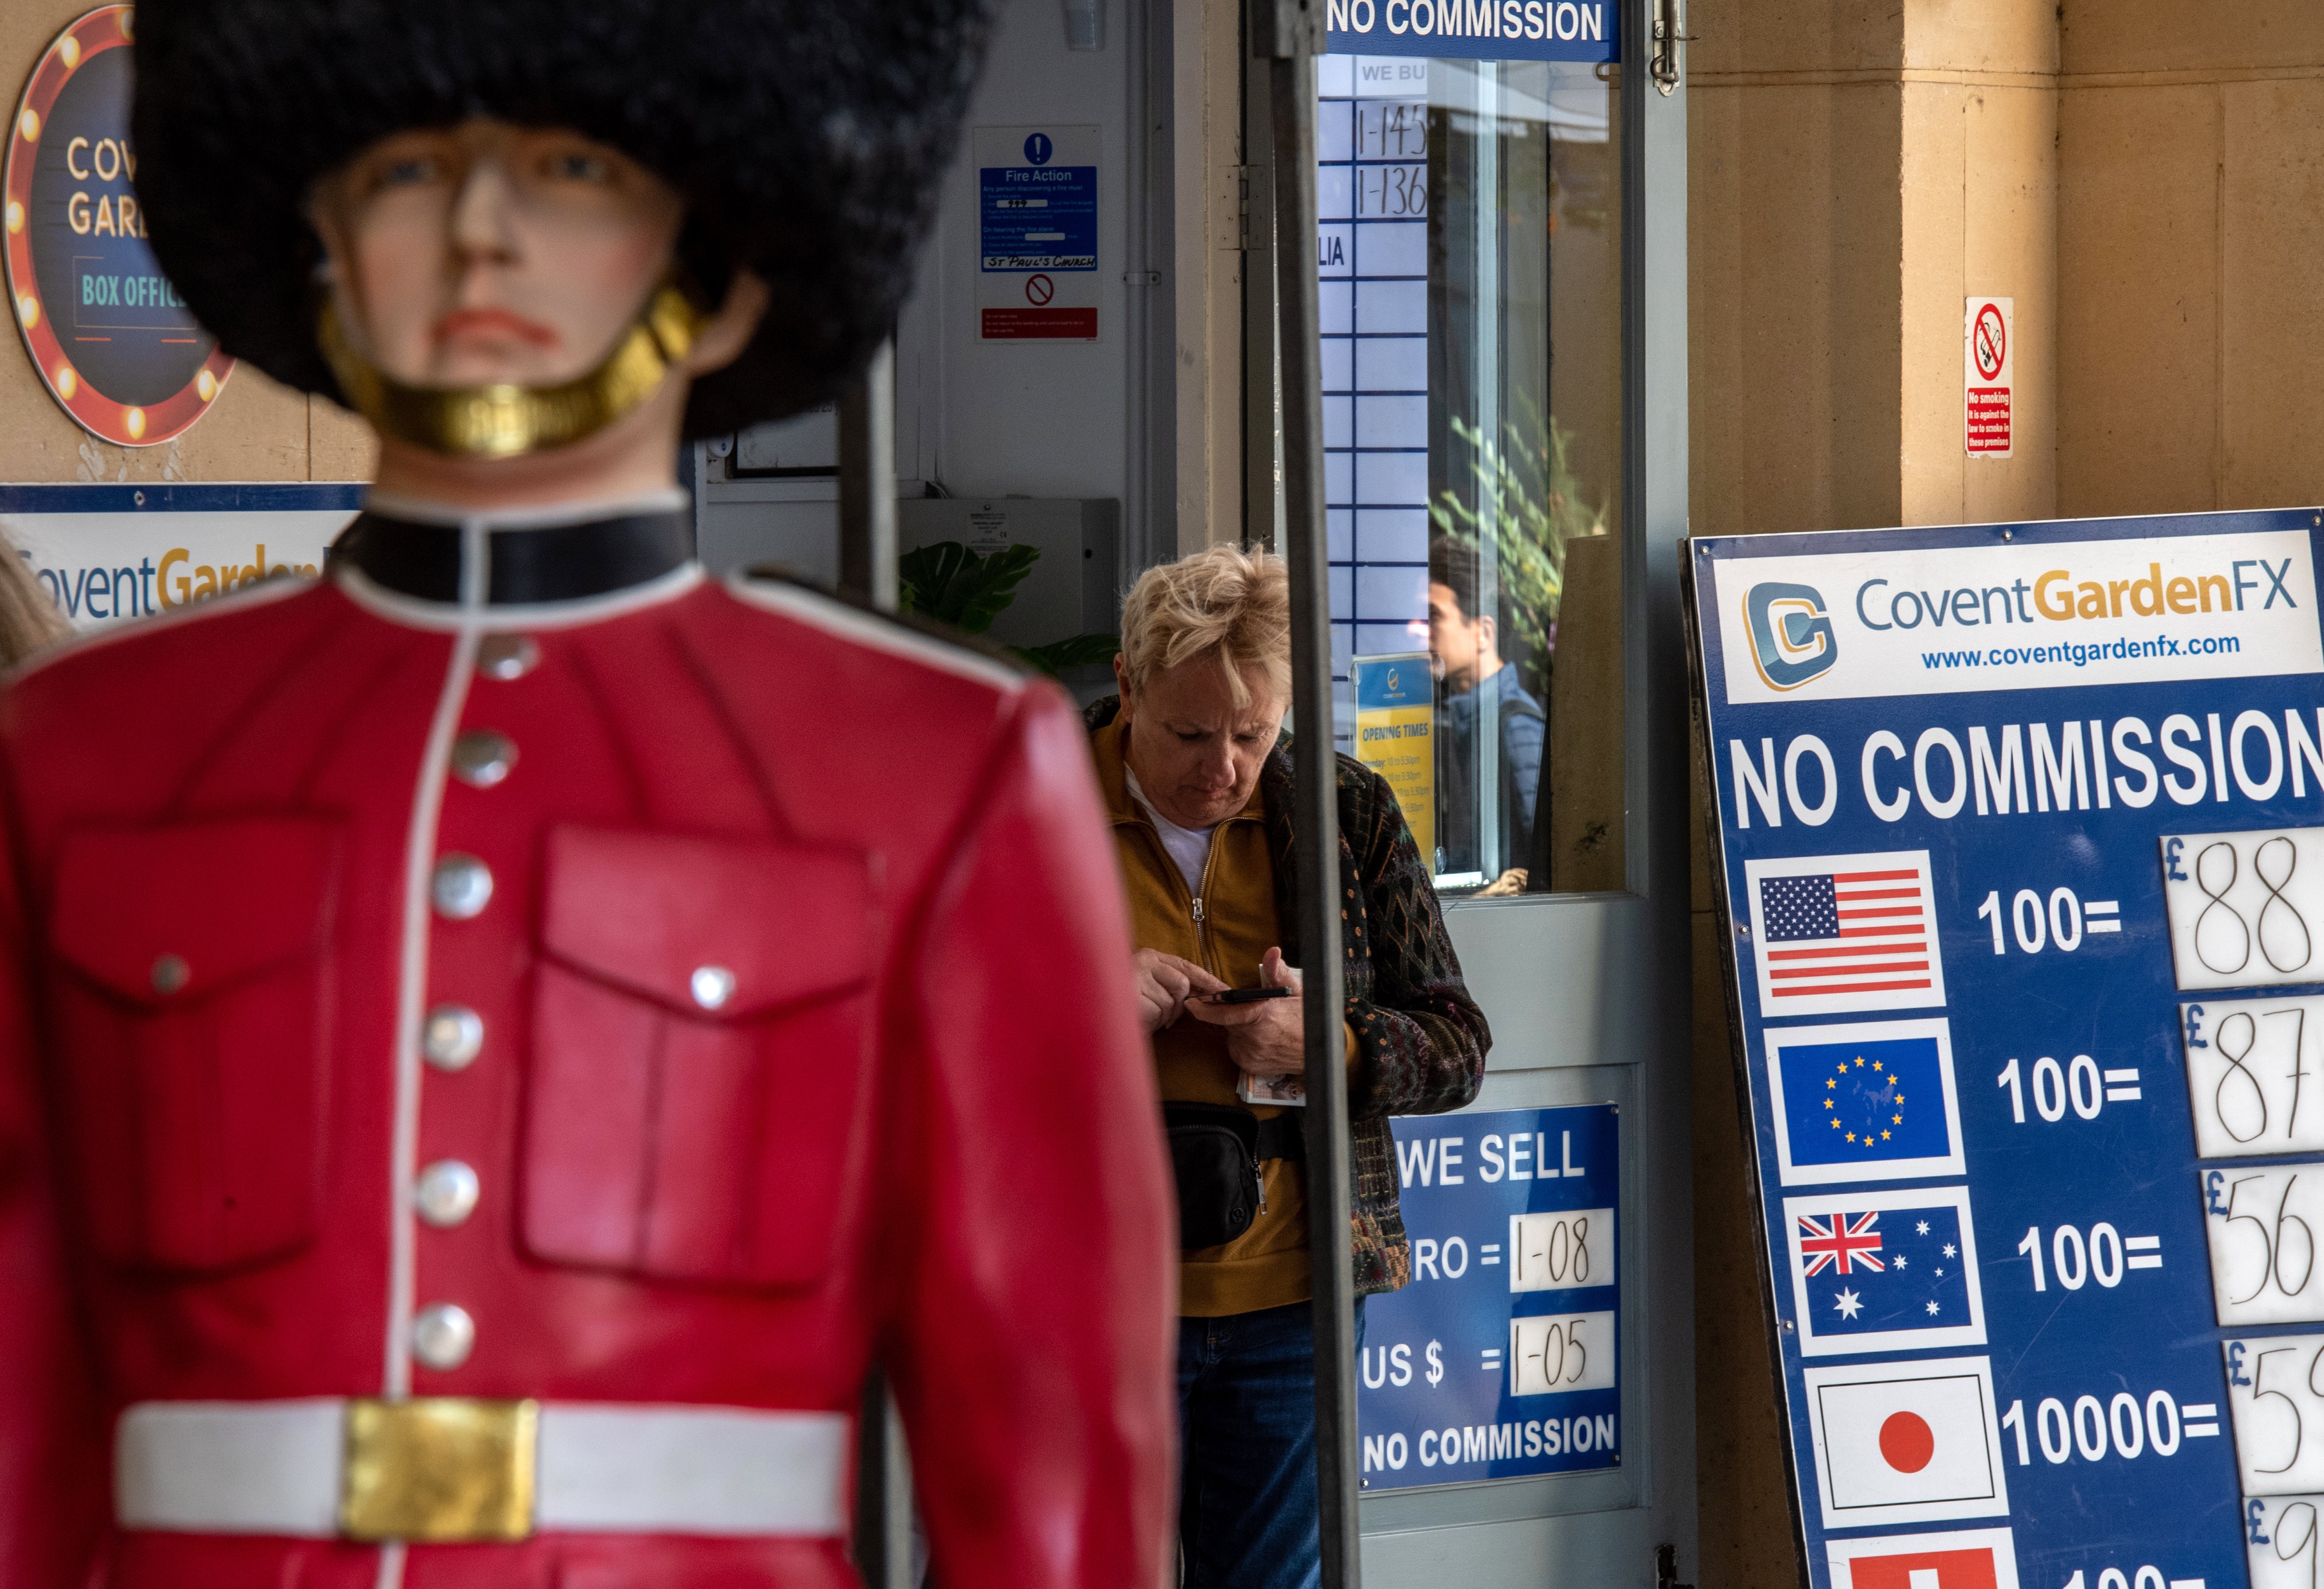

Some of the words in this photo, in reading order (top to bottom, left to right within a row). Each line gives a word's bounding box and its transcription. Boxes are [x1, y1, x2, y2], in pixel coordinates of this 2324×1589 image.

[1327, 0, 1375, 33] NO
[1386, 0, 1601, 41] COMMISSION
[1362, 66, 1392, 81] WE
[1006, 170, 1029, 181] Fire
[1032, 169, 1072, 181] Action
[82, 274, 120, 306] BOX
[124, 276, 188, 307] OFFIC
[1968, 391, 1979, 404] No
[1980, 391, 2009, 406] smoking
[1968, 410, 1973, 419] It
[1974, 409, 1979, 419] is
[1980, 409, 1999, 421] against
[2000, 409, 2009, 419] the
[1968, 423, 1978, 433] law
[1979, 424, 1985, 433] to
[1985, 423, 2003, 432] smoke
[2003, 423, 2009, 432] in
[1969, 437, 1984, 446] these
[1984, 436, 2008, 448] premises
[1856, 557, 2298, 632] CoventGardenFX
[1921, 634, 2241, 671] www.coventgardenfx.com
[1362, 725, 1401, 742] OPENING
[1403, 723, 1428, 737] TIMES
[1730, 734, 1839, 830] NO
[1861, 708, 2324, 823] COMMISSION
[1977, 887, 2122, 955] 100=
[2166, 837, 2188, 881] £
[2195, 836, 2311, 974] 88
[1997, 1054, 2142, 1123] 100=
[2186, 1003, 2208, 1049] £
[2216, 1008, 2311, 1143] 87
[1395, 1137, 1464, 1189] WE
[1479, 1130, 1585, 1184] SELL
[2018, 1222, 2163, 1292] 100=
[2206, 1170, 2229, 1216] £
[2226, 1174, 2315, 1305] 56
[1362, 1343, 1412, 1390] US
[1425, 1338, 1444, 1389] $
[2002, 1389, 2220, 1466] 10000=
[2228, 1341, 2251, 1386] £
[1364, 1432, 1408, 1473] NO
[1419, 1414, 1616, 1468] COMMISSION
[2247, 1499, 2270, 1546] £
